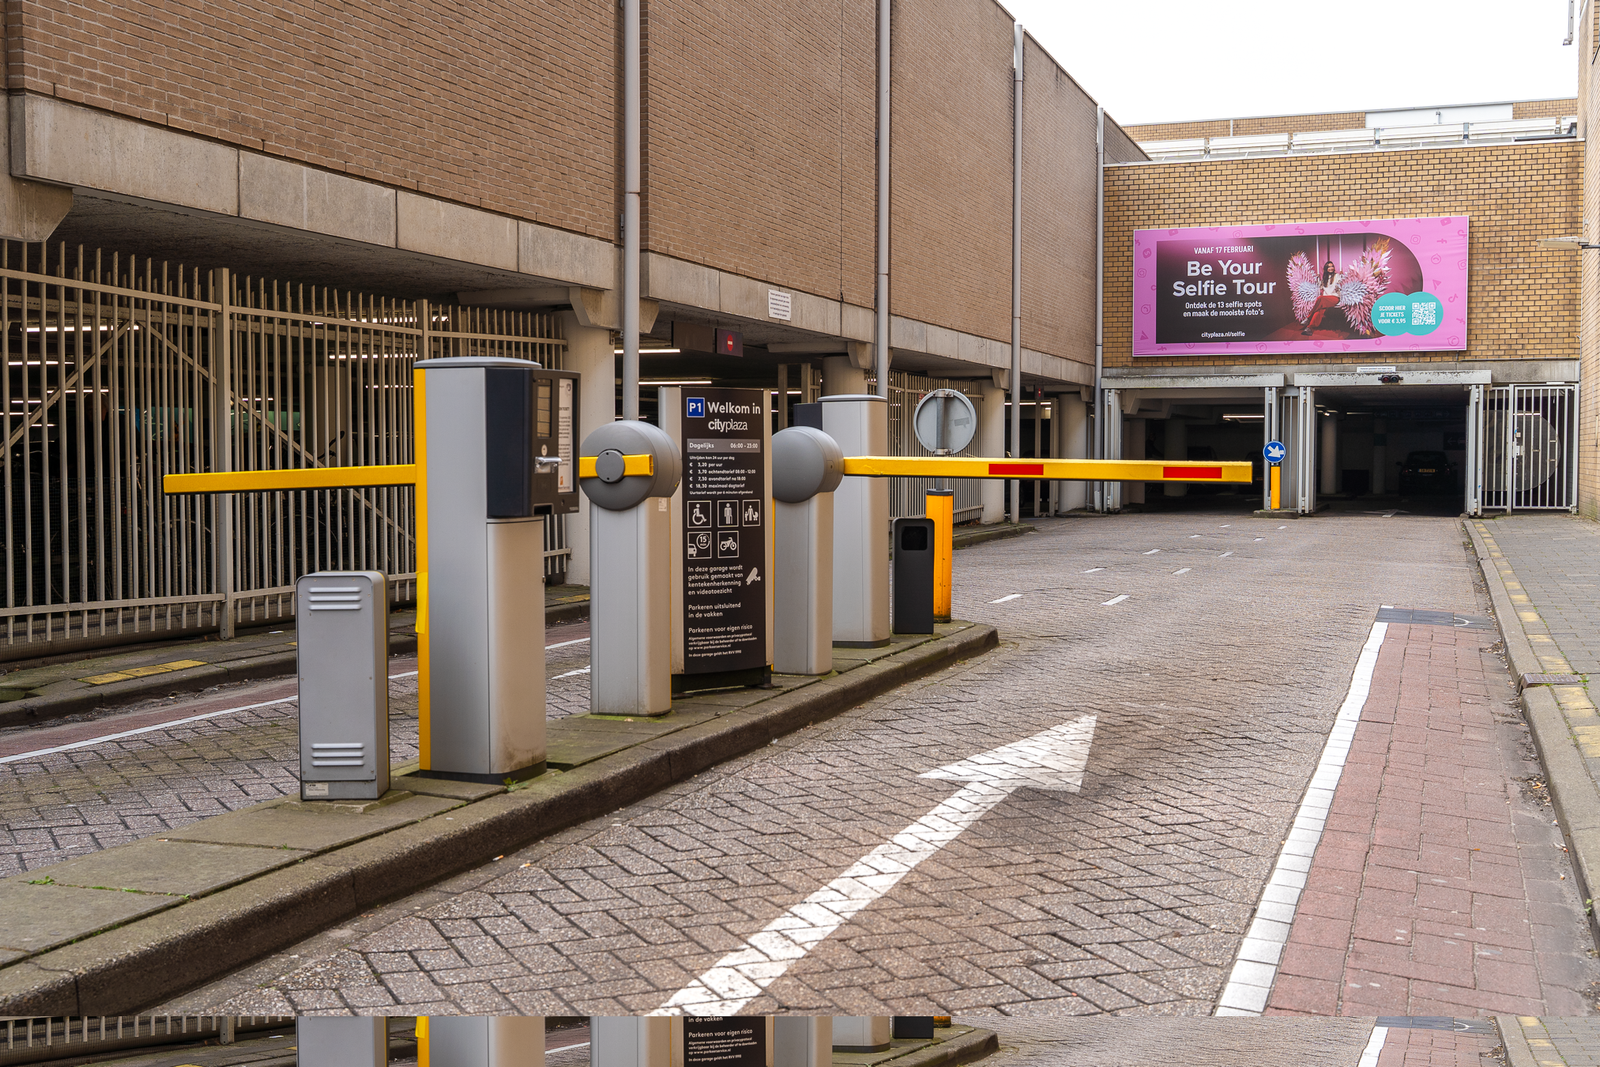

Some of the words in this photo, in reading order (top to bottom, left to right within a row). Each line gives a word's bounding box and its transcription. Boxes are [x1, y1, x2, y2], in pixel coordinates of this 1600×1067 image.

[1187, 260, 1212, 276] Be
[1218, 260, 1262, 276] Your
[1172, 280, 1227, 297] Selfie
[1232, 279, 1276, 295] Tour
[689, 403, 701, 412] P1
[707, 402, 750, 413] Welkom
[753, 403, 760, 414] in
[708, 419, 748, 432] cityplaza
